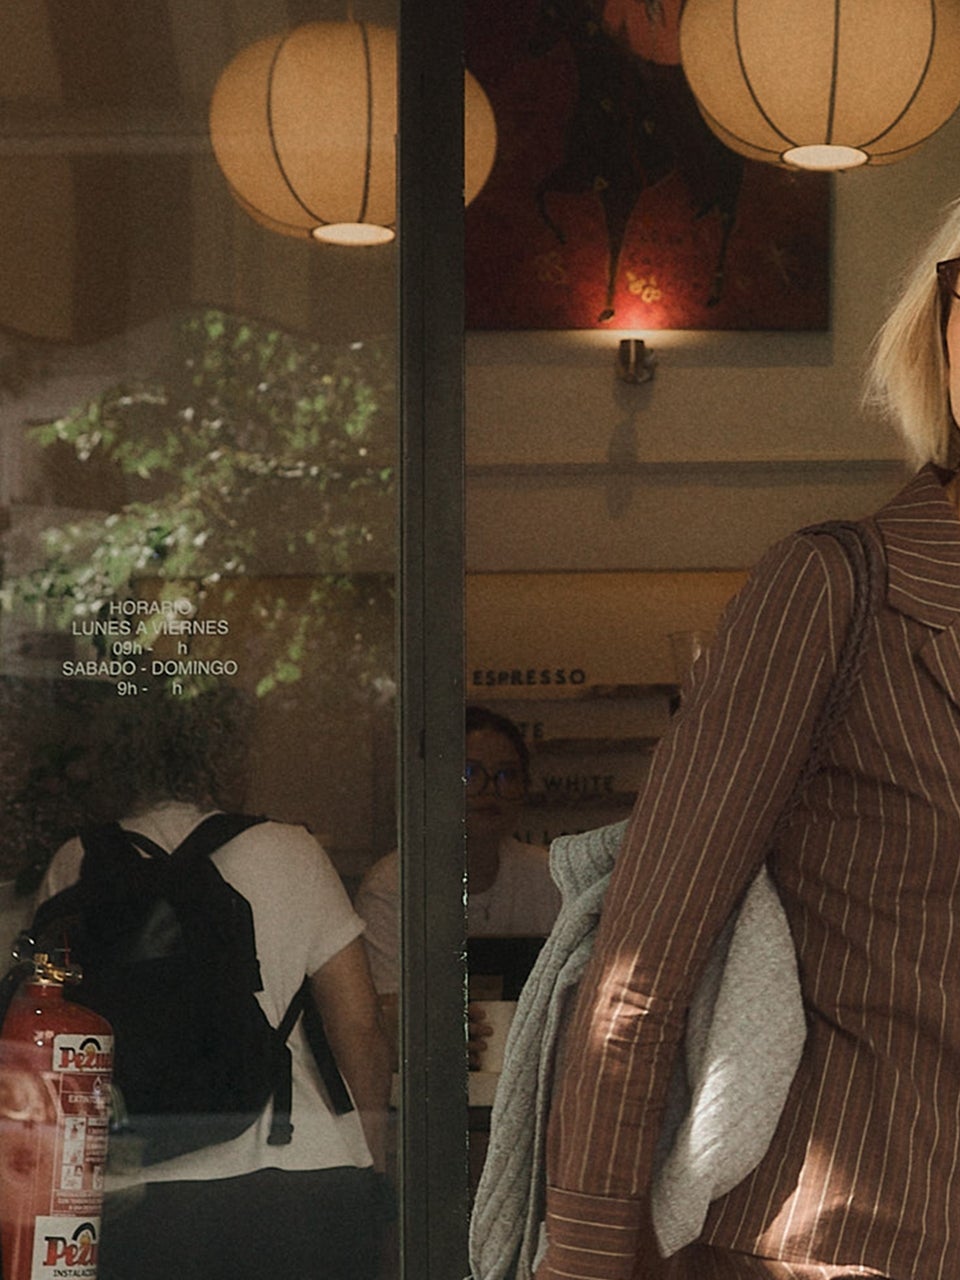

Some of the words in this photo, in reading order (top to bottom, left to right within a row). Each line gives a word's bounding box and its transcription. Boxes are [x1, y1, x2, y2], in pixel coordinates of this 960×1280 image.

[109, 600, 193, 616] HORARIO
[72, 620, 132, 636] LUNES
[135, 620, 148, 635] A
[151, 620, 230, 636] VIERNES
[112, 641, 142, 656] 09h
[61, 660, 137, 677] SABADO
[151, 660, 239, 677] DOMINGO
[472, 668, 588, 686] ESPRESSO
[117, 681, 138, 696] 9h
